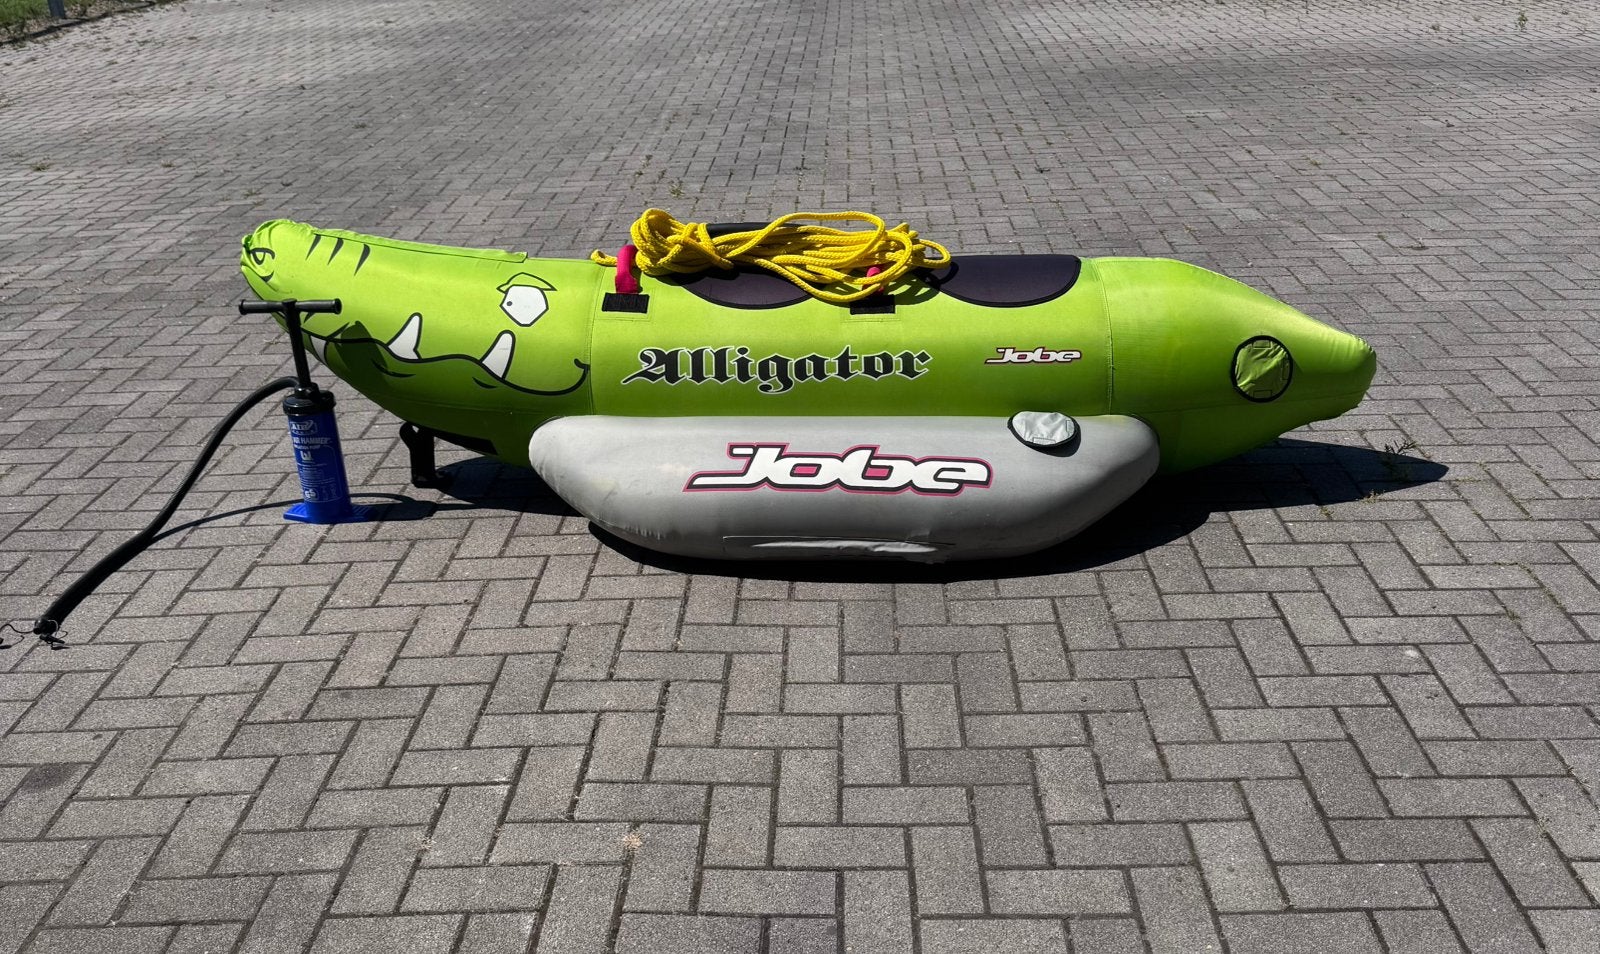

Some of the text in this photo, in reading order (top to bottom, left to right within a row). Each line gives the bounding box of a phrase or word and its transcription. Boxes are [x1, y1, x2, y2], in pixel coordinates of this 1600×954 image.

[620, 345, 933, 394] Alligator
[984, 347, 1082, 365] Jobe
[682, 442, 994, 496] Jobe
